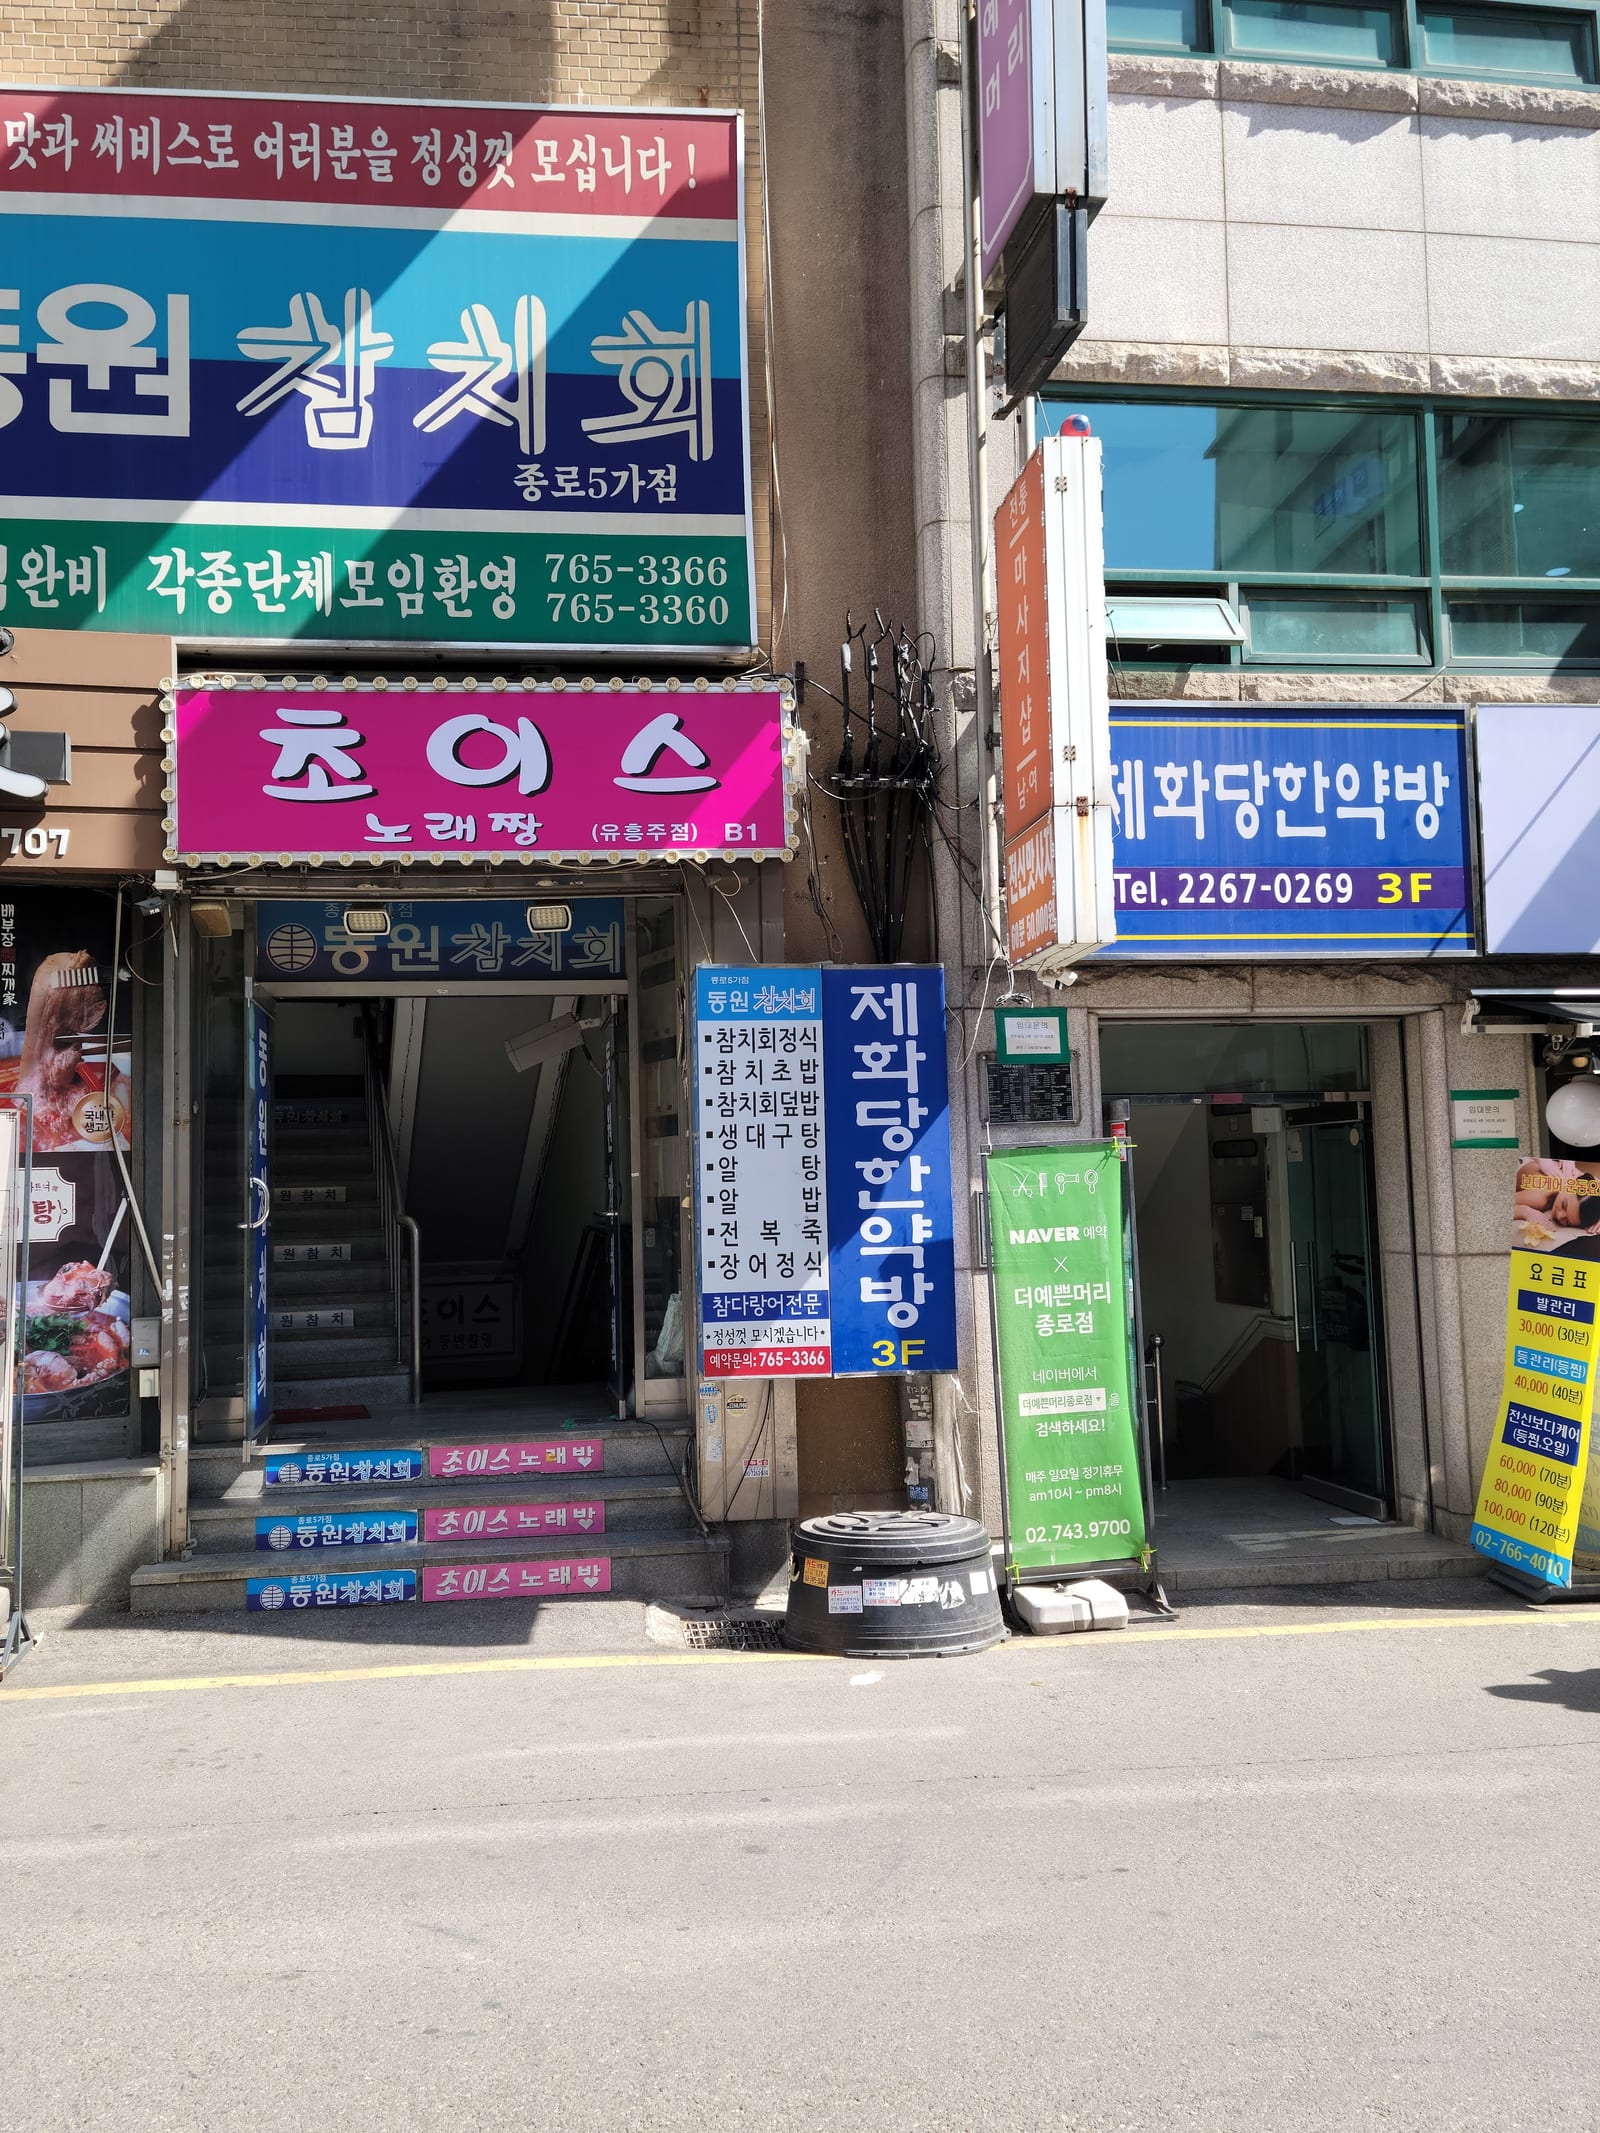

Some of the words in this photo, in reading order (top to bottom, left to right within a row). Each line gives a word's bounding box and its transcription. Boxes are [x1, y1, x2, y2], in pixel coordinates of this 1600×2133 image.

[3, 112, 79, 172] 맛과
[90, 116, 239, 176] 써비스로
[253, 121, 399, 183] 여러분을
[411, 128, 516, 189] 정성껏
[513, 462, 678, 503] 종로5가점
[544, 553, 727, 586] 765-3366
[546, 593, 729, 625] 765-3360
[259, 708, 718, 802] 초이스
[364, 813, 544, 846] 노래짱
[591, 822, 698, 843] (유흥주점)
[724, 823, 758, 841] B1
[1113, 872, 1168, 905] Tel.
[1178, 873, 1352, 904] 2267-0269
[1377, 873, 1432, 904] 3F
[717, 1027, 817, 1053] 참치회정식
[717, 1091, 819, 1117] 참치회덮밥
[850, 982, 934, 1329] 제화당한약방
[1009, 1226, 1080, 1245] NAVER
[1083, 1225, 1108, 1240] 예약
[1530, 1263, 1587, 1289] 요금표
[713, 1294, 822, 1317] 참다랑어전문
[1014, 1281, 1111, 1309] 더예쁜머리
[1536, 1296, 1576, 1317] 발관리
[713, 1328, 747, 1345] 정성껏
[751, 1326, 818, 1344] 모시겠습니다
[1035, 1311, 1094, 1337] 종로점
[1519, 1318, 1554, 1338] 30,000
[1557, 1325, 1590, 1346] (30분)
[758, 1351, 825, 1367] 765-3366
[871, 1339, 925, 1367] 3F
[1032, 1366, 1098, 1384] 네이버에서
[1514, 1375, 1549, 1395] 40,000
[1551, 1383, 1584, 1406] (40분)
[1035, 1418, 1106, 1438] 검색하세요!
[1508, 1408, 1580, 1443] 전신보디케어
[442, 1448, 511, 1473] 초이스
[1026, 1471, 1047, 1483] 매주
[1050, 1467, 1080, 1481] 일요일
[1082, 1465, 1123, 1479] 정기휴무
[1499, 1455, 1537, 1478] 60,000
[1539, 1466, 1573, 1491] (70분)
[1029, 1486, 1073, 1502] am10시
[1085, 1483, 1122, 1499] pm8시
[1494, 1478, 1533, 1502] 80,000
[1534, 1491, 1569, 1516] (90분)
[437, 1510, 509, 1535] 초이스
[1026, 1519, 1131, 1543] 02.743.9700
[1483, 1499, 1527, 1526] 100,000
[1529, 1515, 1571, 1544] (120분)
[1475, 1530, 1564, 1579] 02-766-4010
[436, 1568, 511, 1596] 초이스
